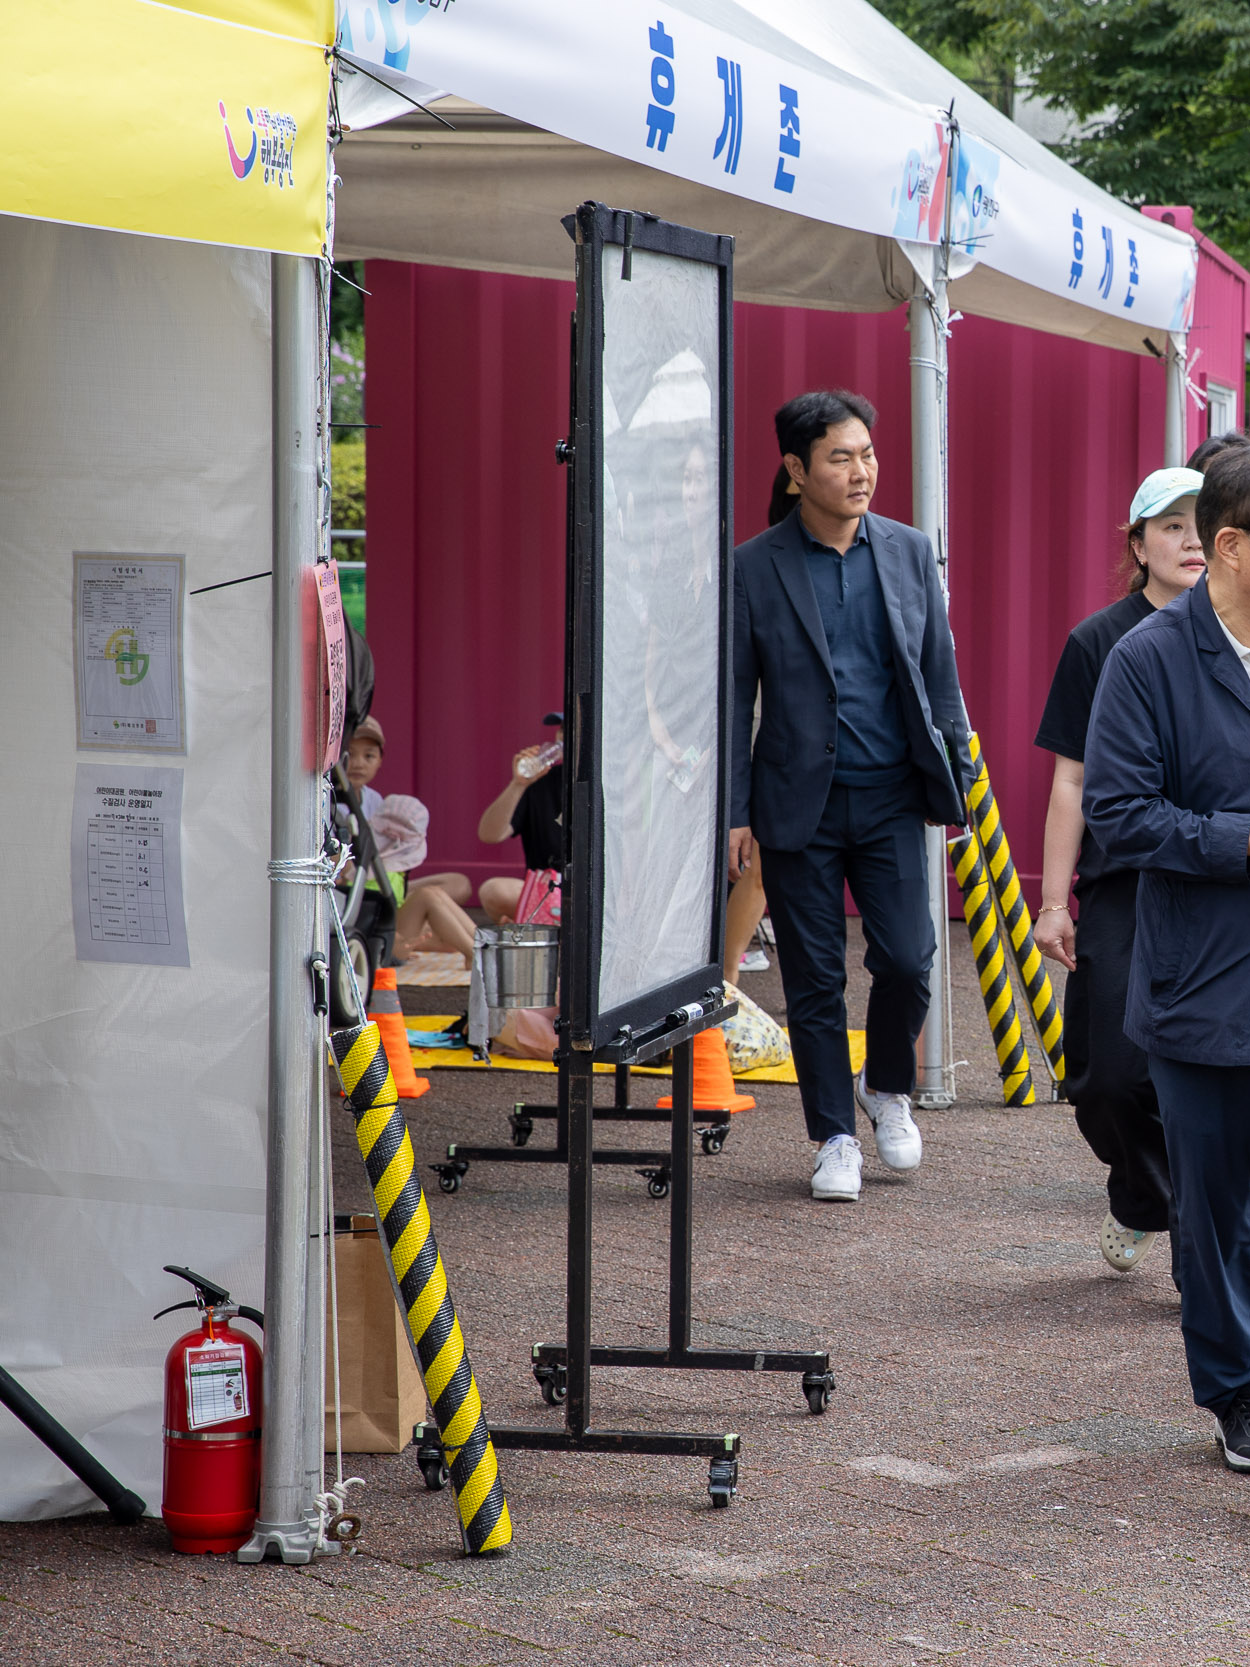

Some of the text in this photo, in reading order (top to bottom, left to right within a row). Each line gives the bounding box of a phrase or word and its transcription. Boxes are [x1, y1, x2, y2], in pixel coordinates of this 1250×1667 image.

[645, 19, 801, 194] 휴게존
[260, 135, 294, 188] 행복광진
[982, 195, 1000, 220] 광진구
[1067, 207, 1140, 309] 휴게존
[95, 786, 126, 796] 어린이대공원
[101, 797, 153, 809] 수질검사 운영일지
